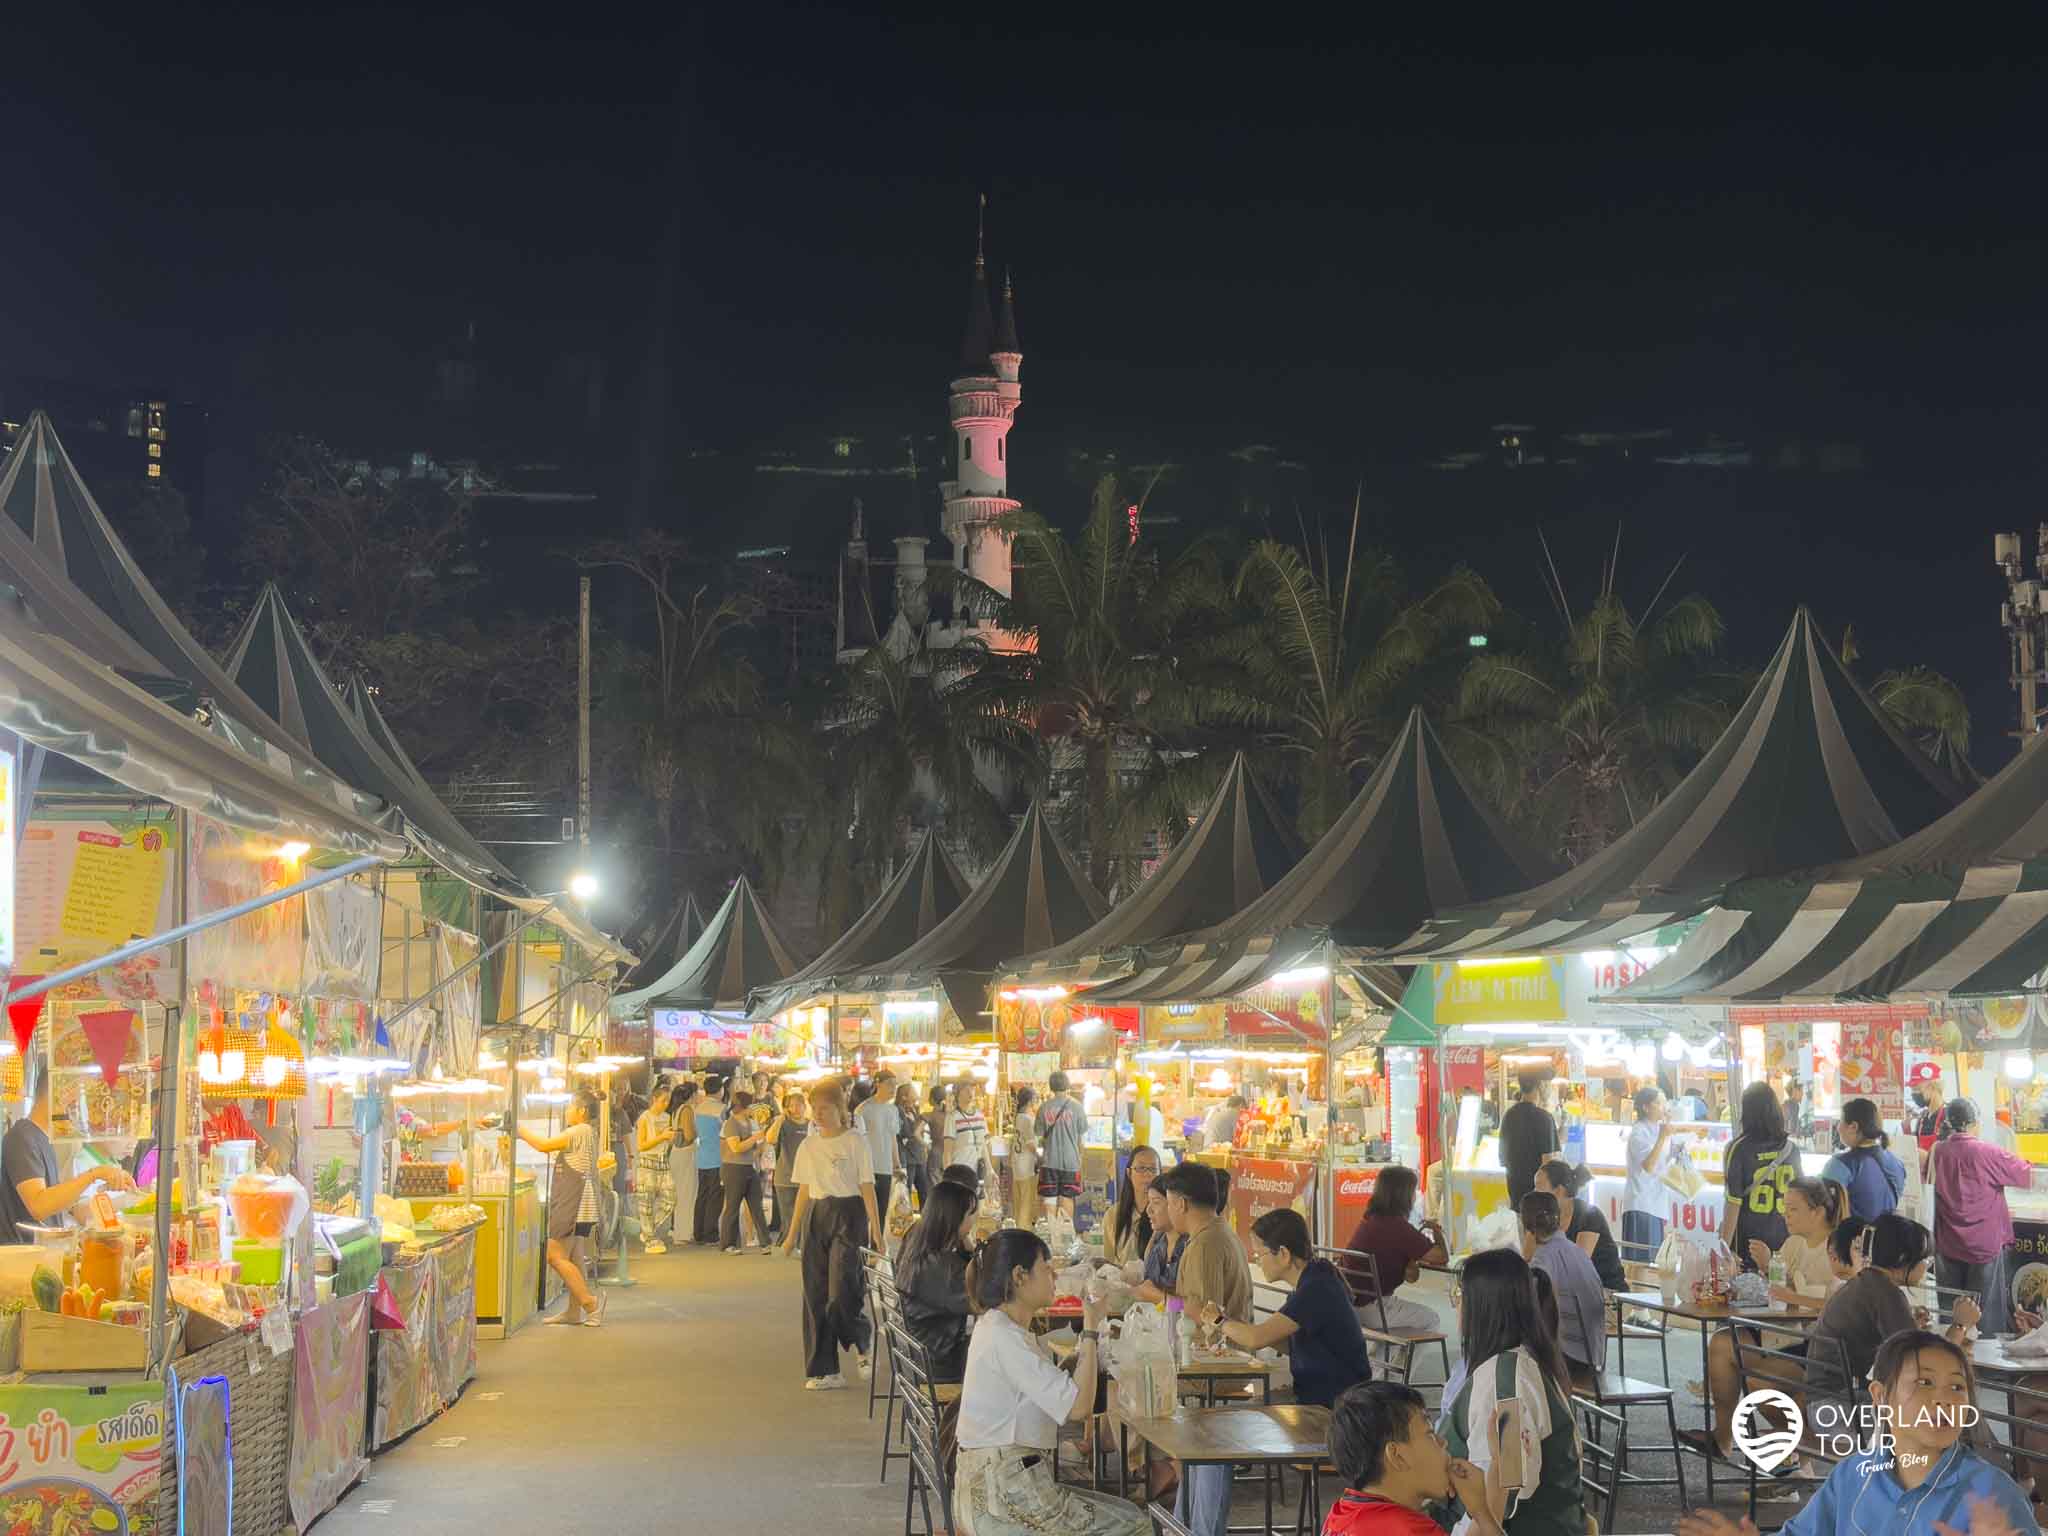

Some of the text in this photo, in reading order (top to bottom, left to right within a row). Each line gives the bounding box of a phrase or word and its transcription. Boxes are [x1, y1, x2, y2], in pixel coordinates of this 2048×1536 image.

[1452, 978, 1505, 1003] LEMN
[28, 1411, 69, 1463] ยำ
[98, 1401, 159, 1444] รสเด็ด
